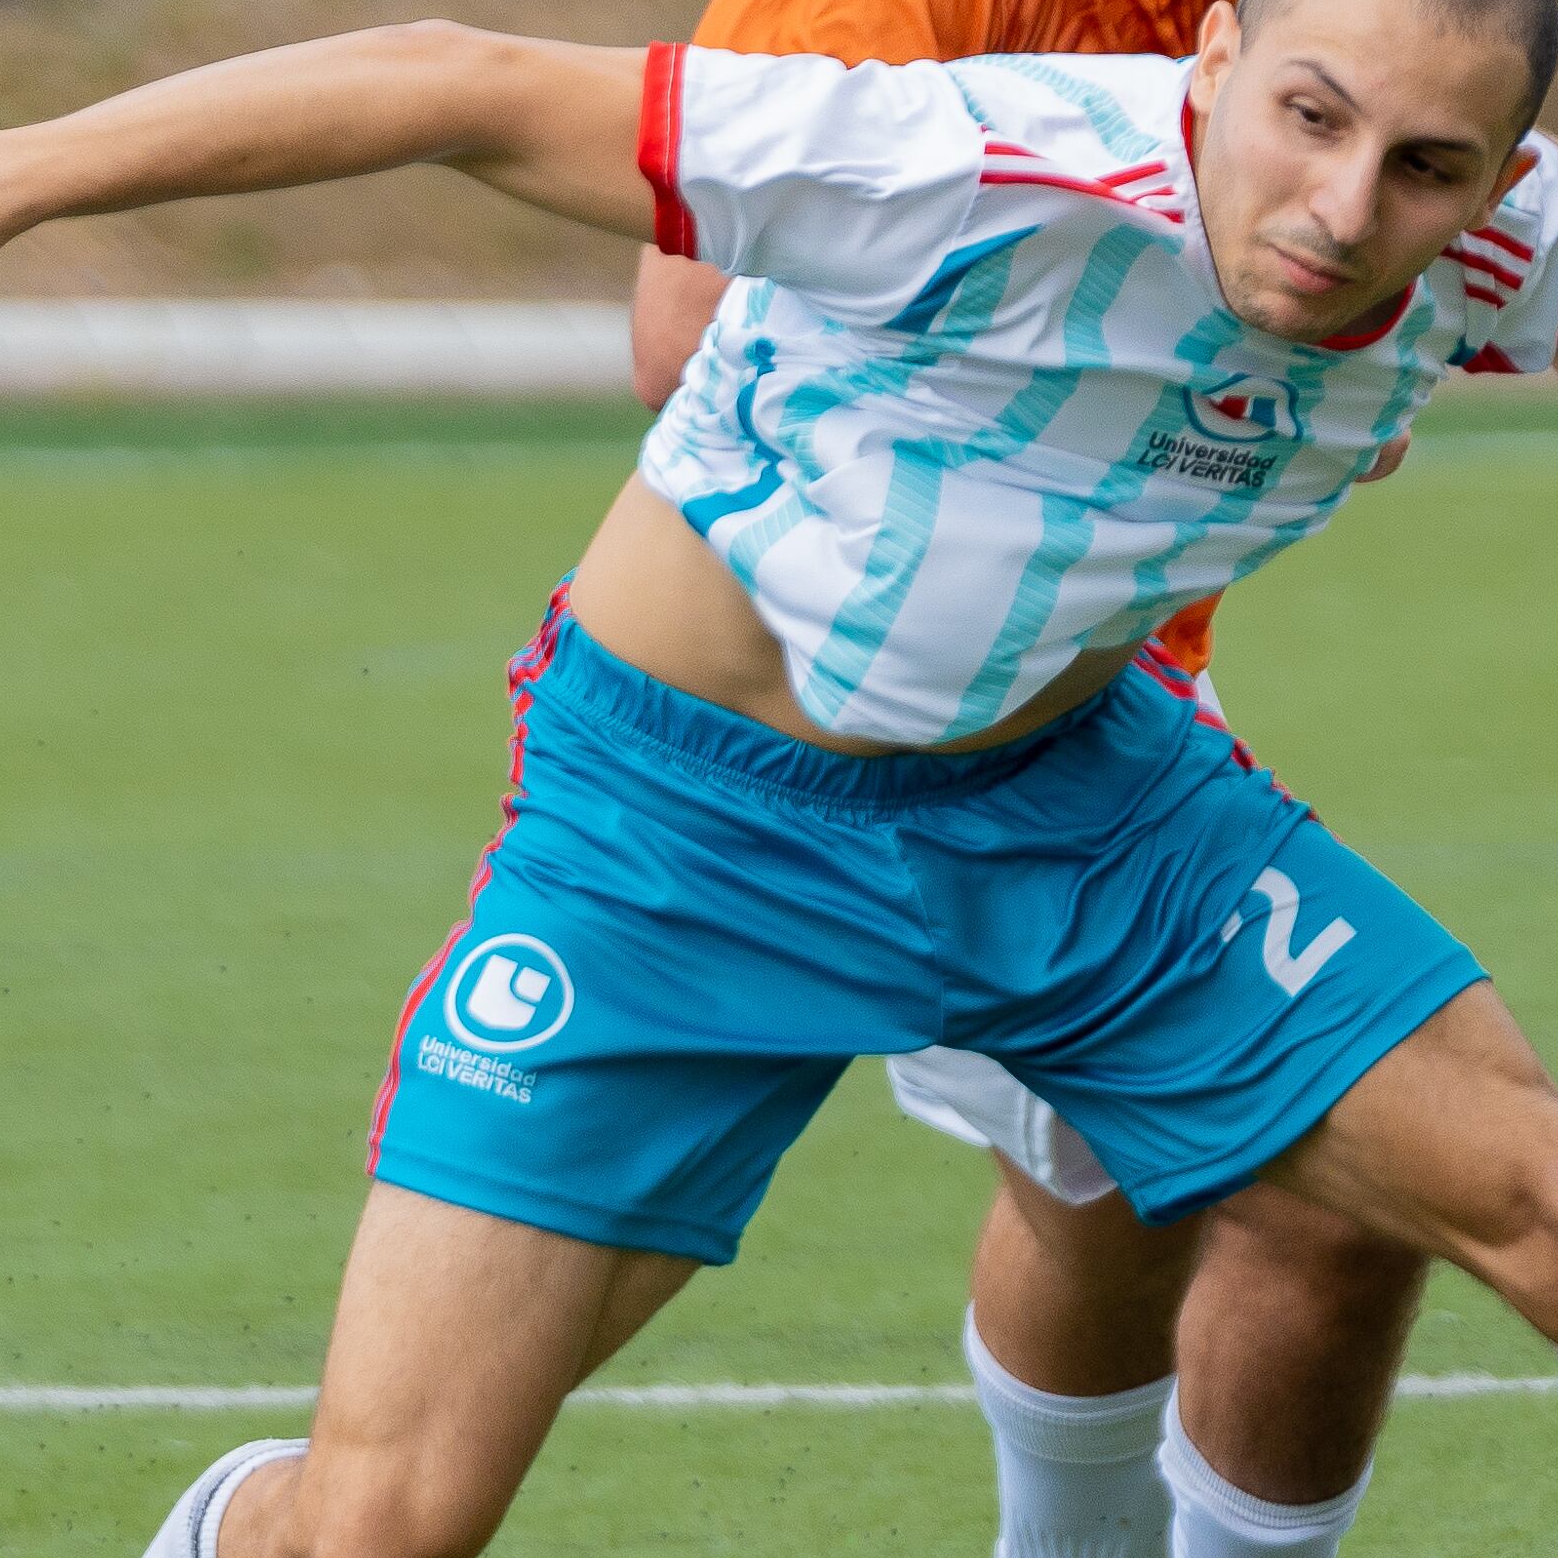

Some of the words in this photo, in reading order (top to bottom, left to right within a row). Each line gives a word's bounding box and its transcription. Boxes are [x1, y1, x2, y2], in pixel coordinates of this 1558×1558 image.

[1149, 431, 1277, 469] Universidad
[1179, 456, 1266, 487] VERITAS
[1221, 865, 1357, 998] 2
[420, 1035, 537, 1087] Universidad
[447, 1059, 532, 1104] VERITAS
